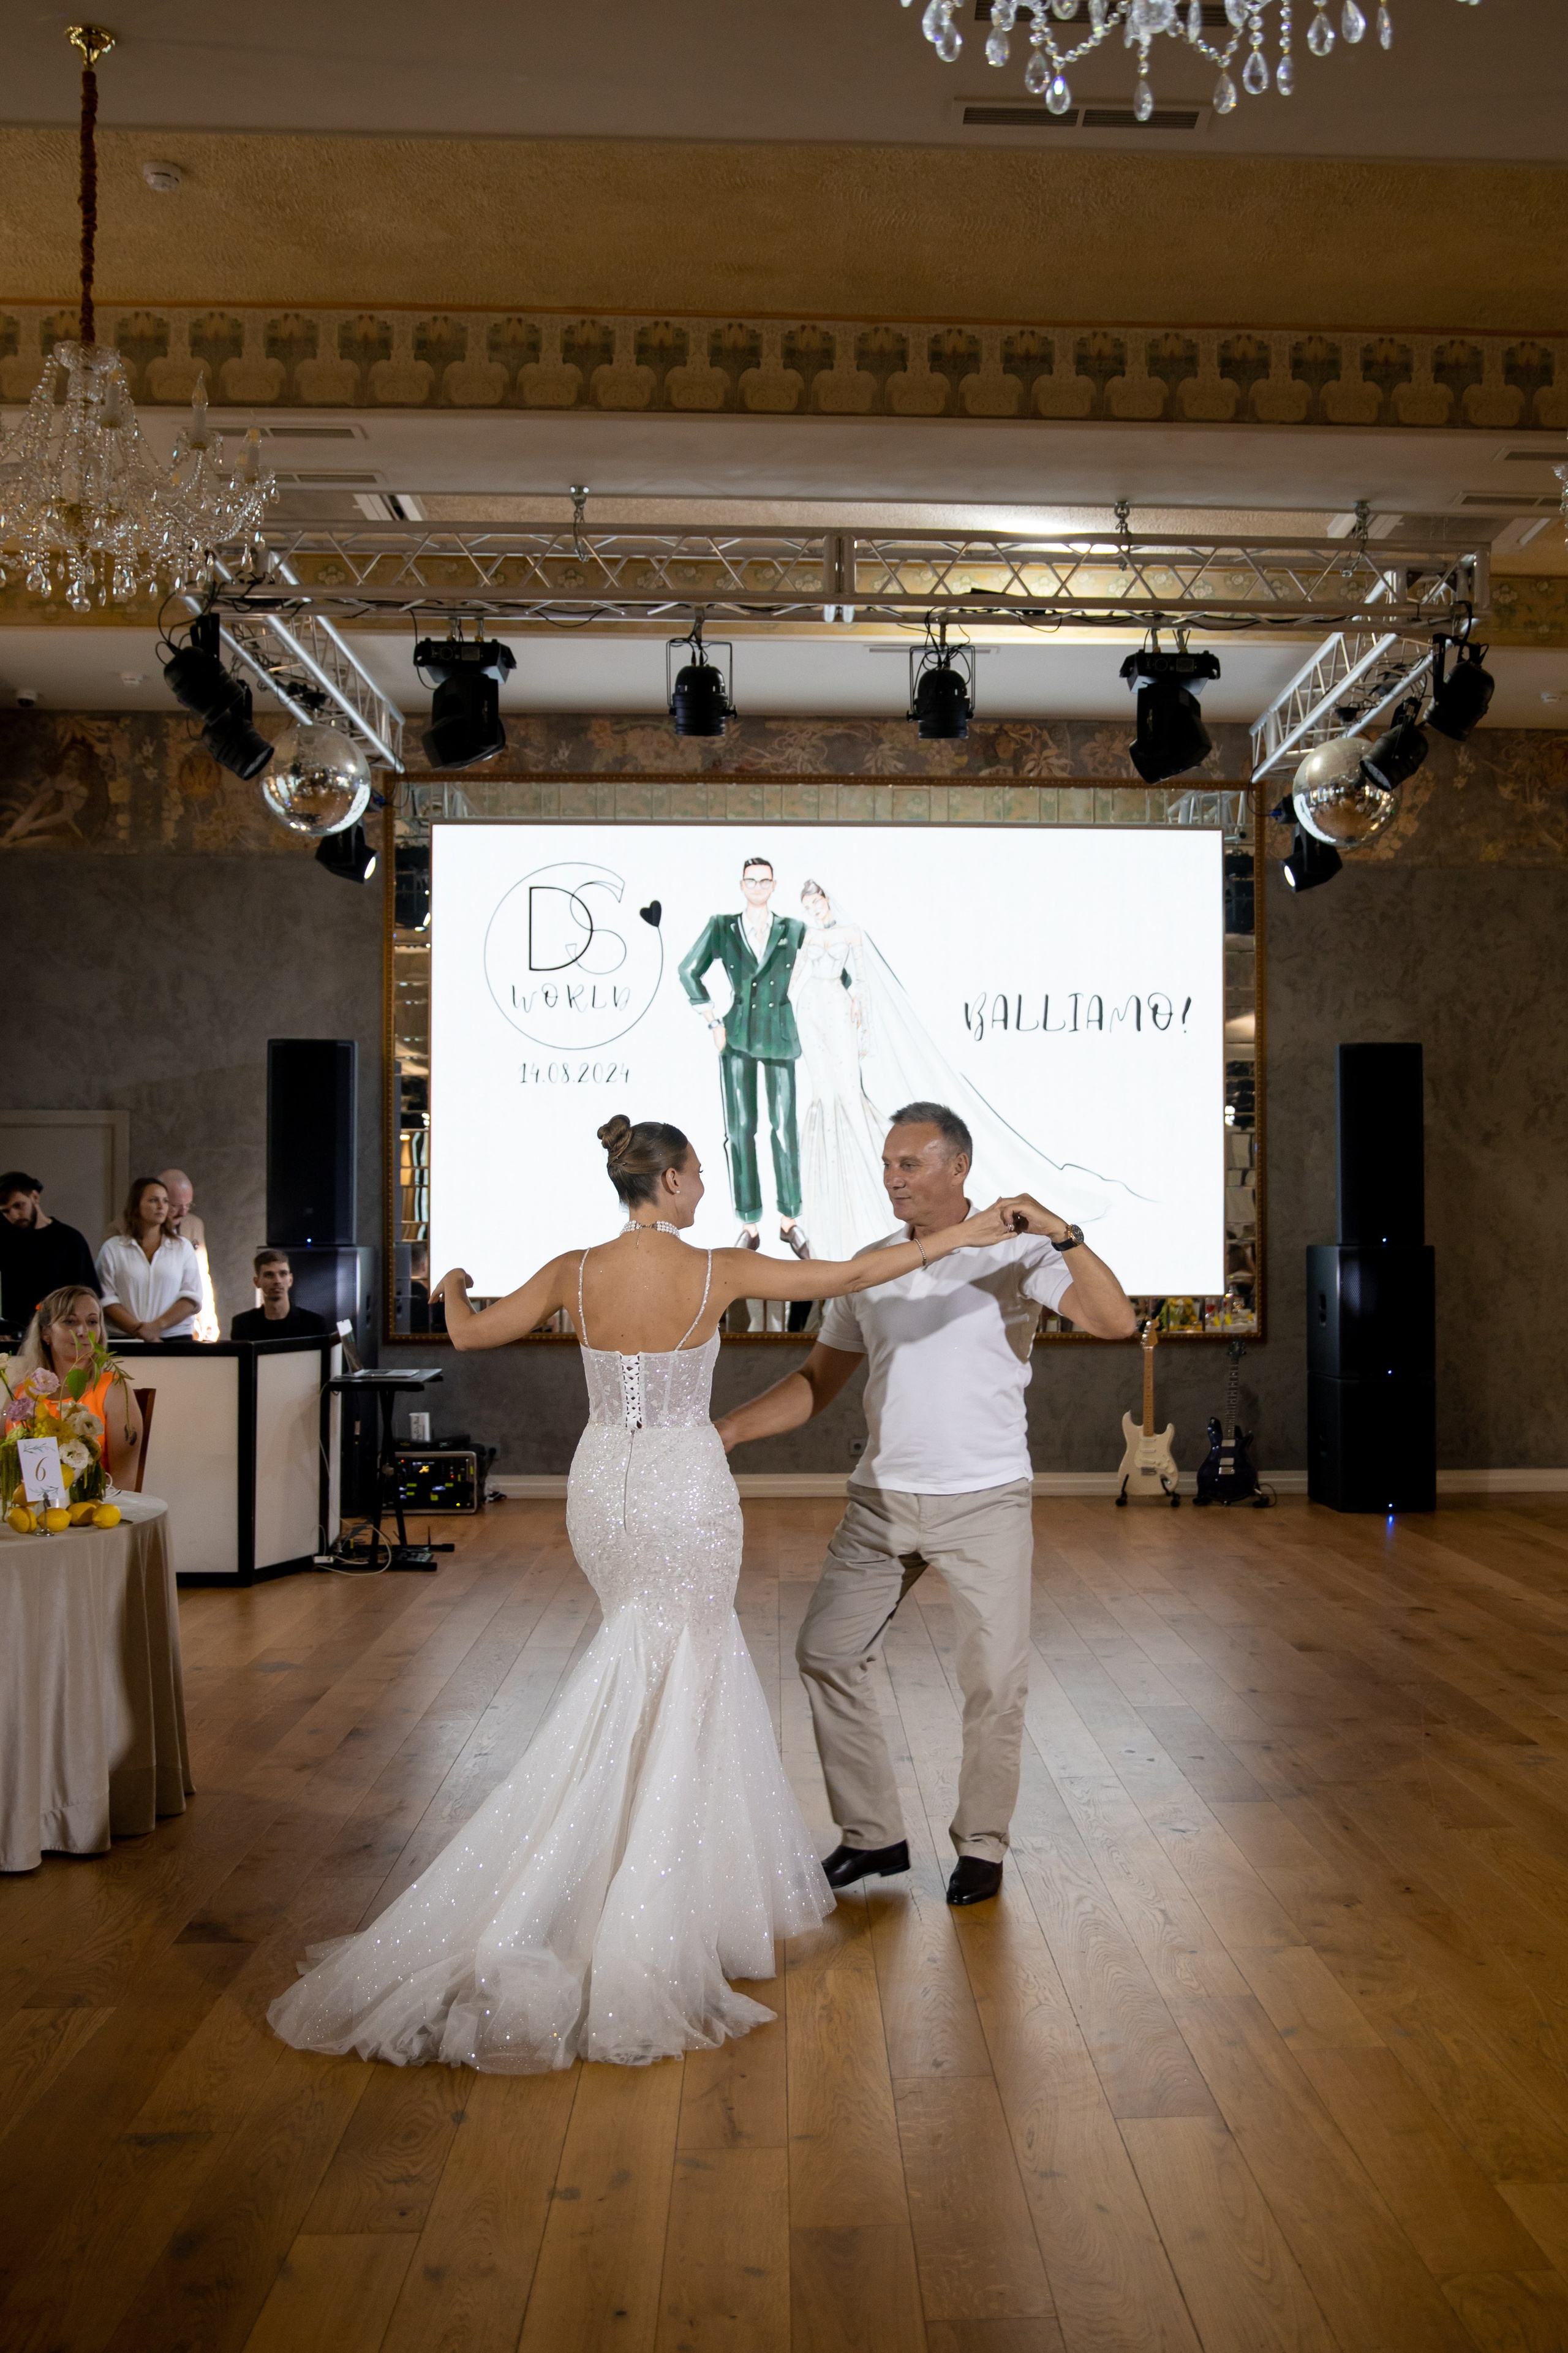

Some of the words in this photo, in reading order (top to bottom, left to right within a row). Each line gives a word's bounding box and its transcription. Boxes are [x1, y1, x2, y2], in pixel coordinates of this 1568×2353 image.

[512, 983, 631, 1013] WORLD
[965, 992, 1192, 1041] BALLIAMO!
[519, 1062, 630, 1084] 14.08.2024
[36, 1457, 48, 1481] 6
